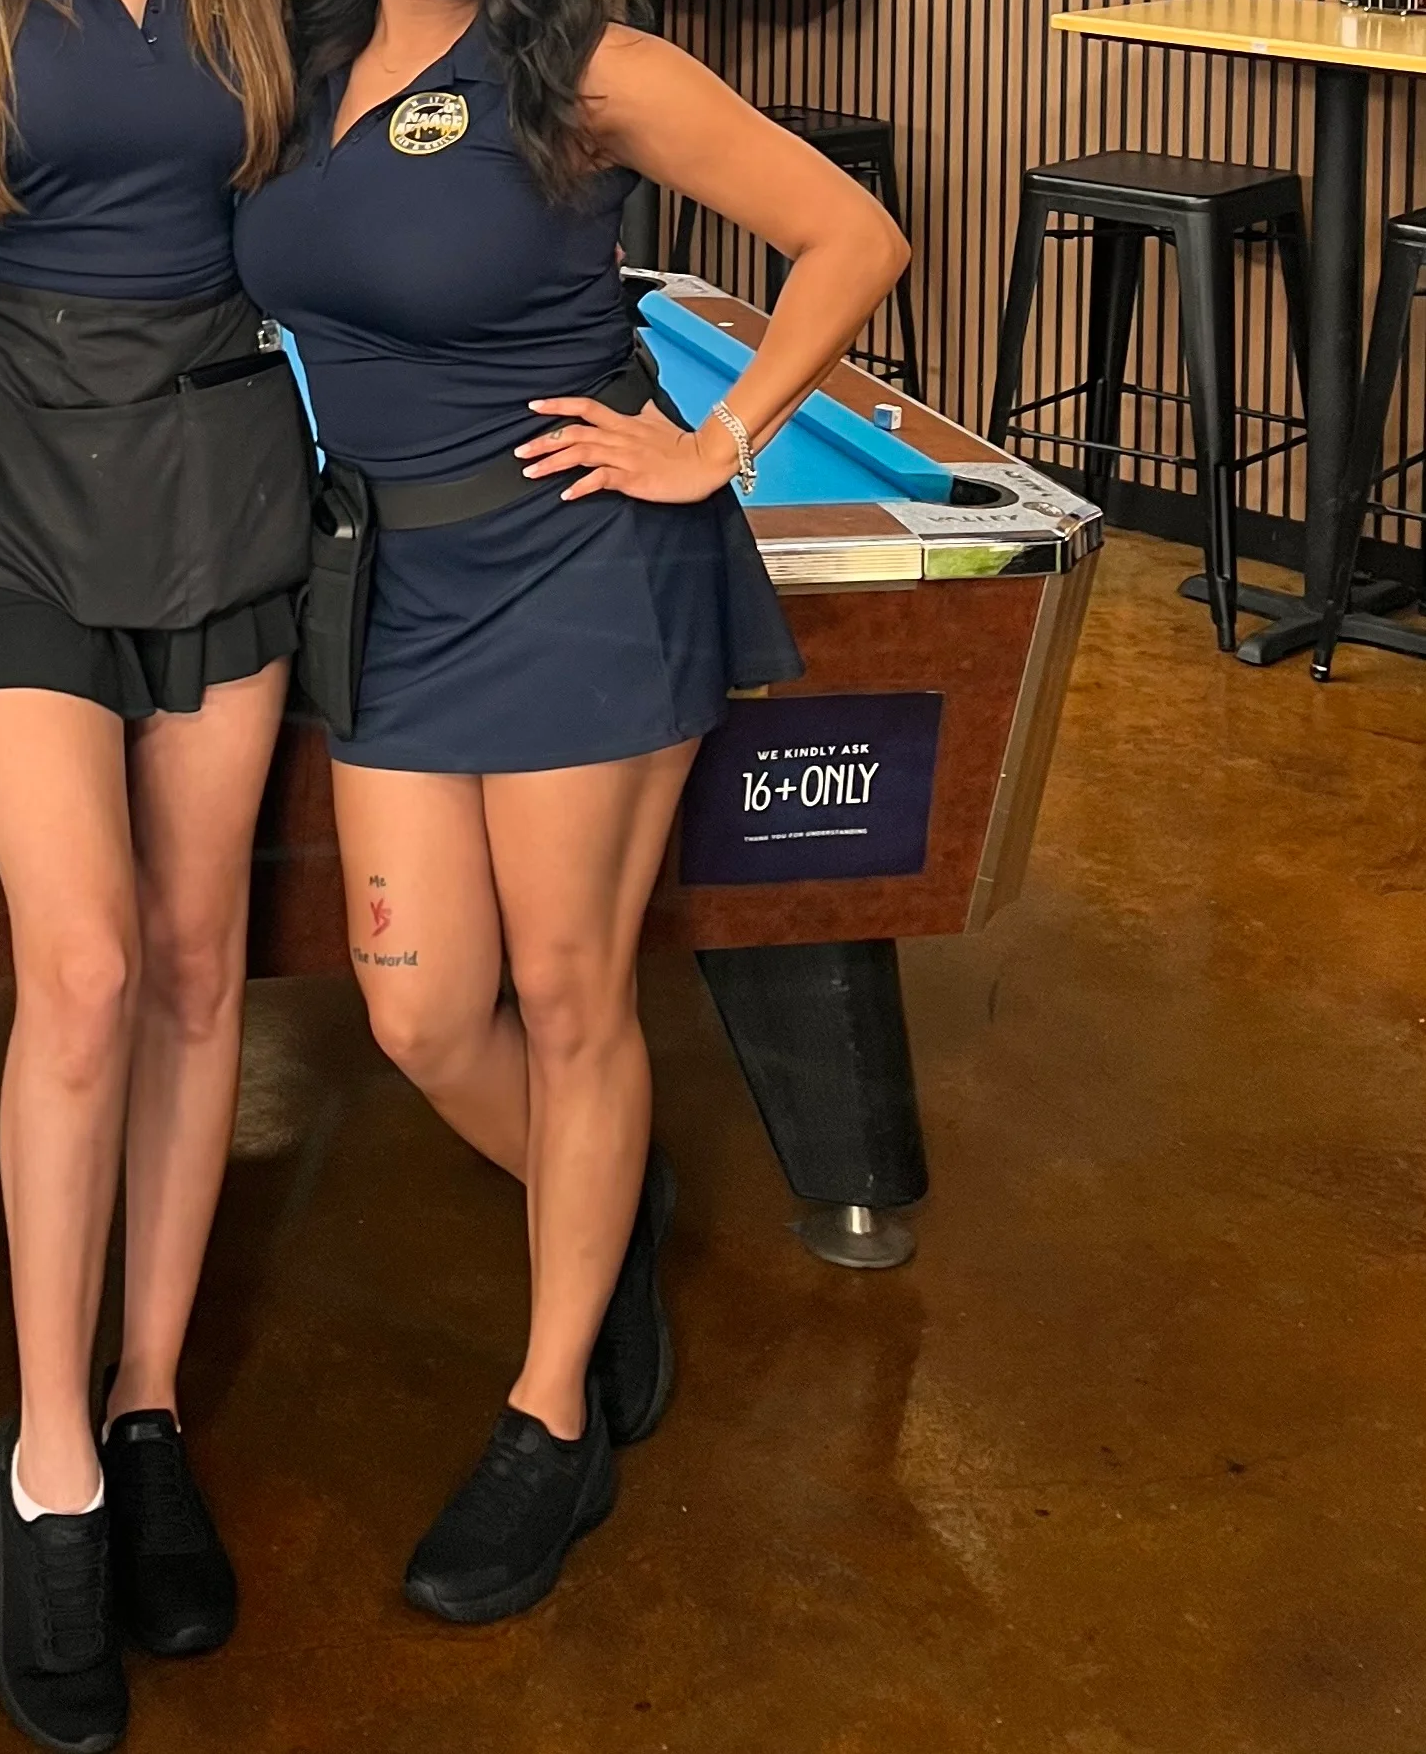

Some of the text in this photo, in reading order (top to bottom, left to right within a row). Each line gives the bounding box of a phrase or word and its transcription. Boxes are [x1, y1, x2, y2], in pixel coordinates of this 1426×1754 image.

[927, 513, 1019, 523] VALLEY
[757, 743, 870, 760] WE KINDLY ASK
[800, 762, 881, 808] ONLY
[770, 832, 788, 841] YOU
[788, 831, 805, 839] FOR
[368, 874, 386, 888] Me
